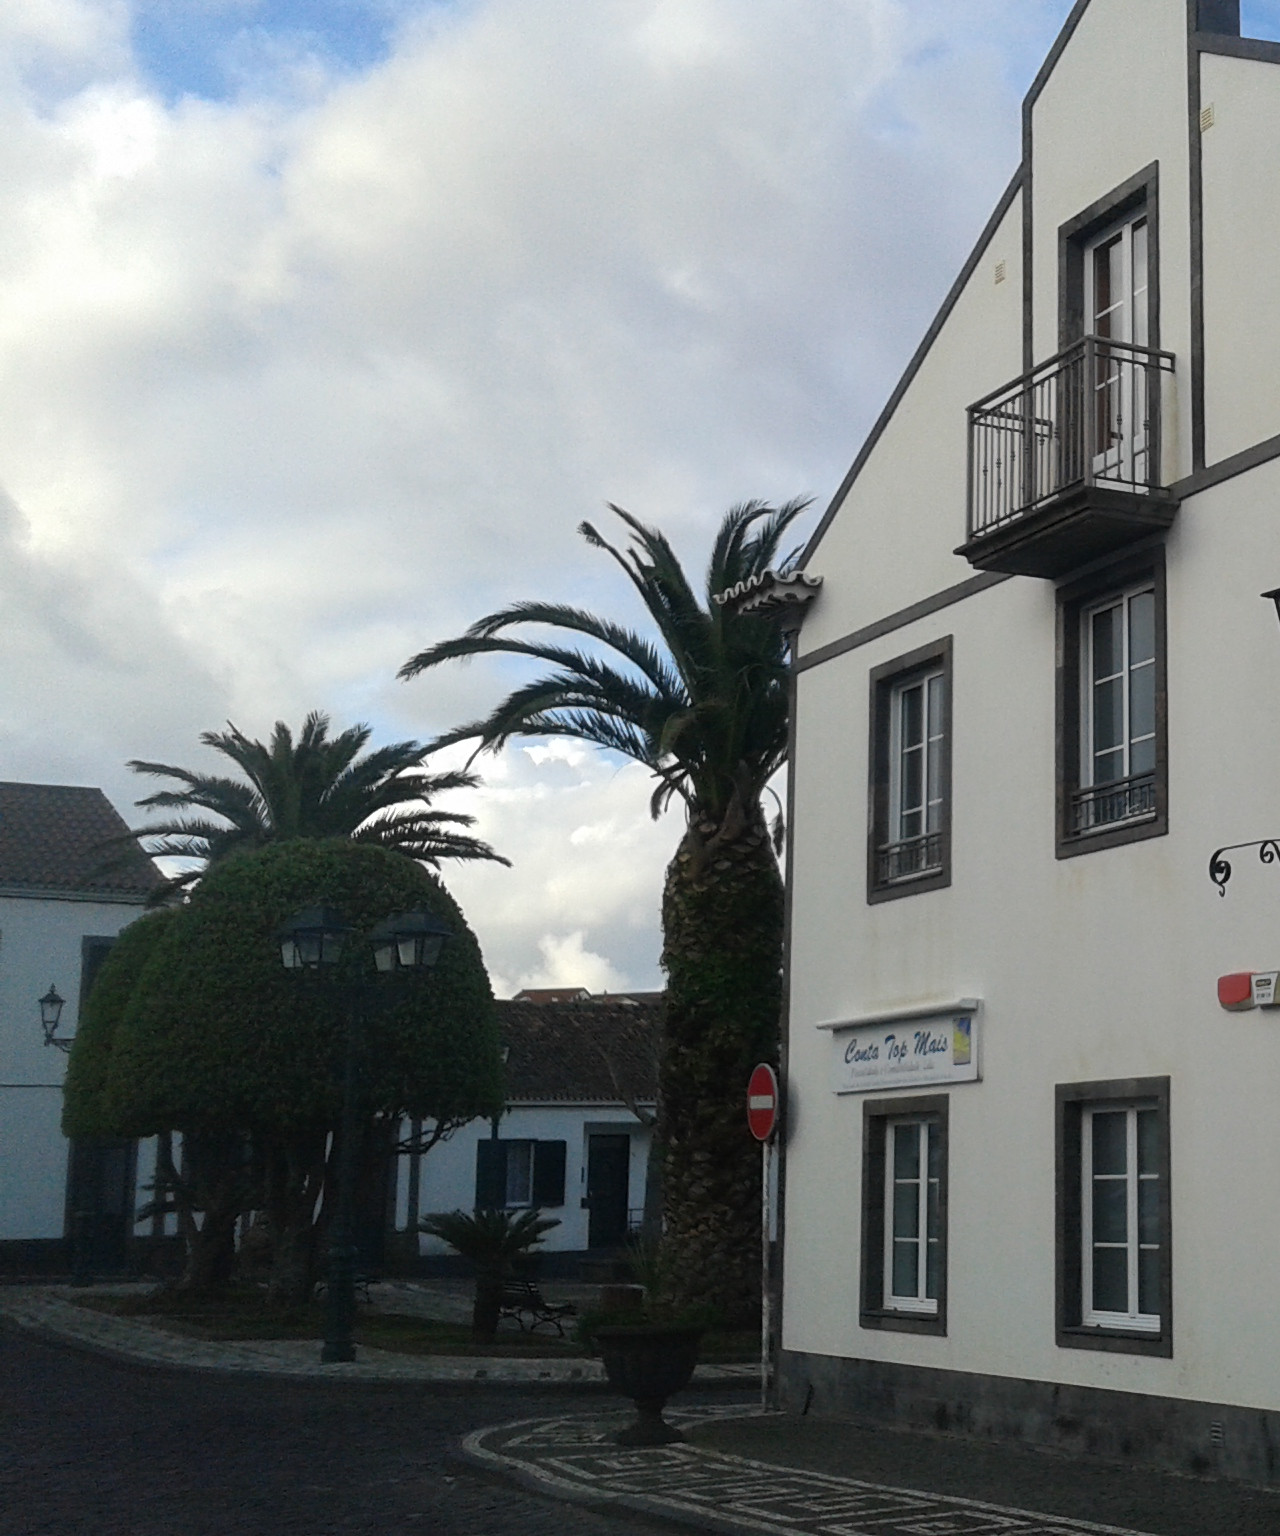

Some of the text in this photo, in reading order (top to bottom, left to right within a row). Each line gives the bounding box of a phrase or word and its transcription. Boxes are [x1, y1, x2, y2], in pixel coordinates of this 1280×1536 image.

[844, 1030, 948, 1064] Conta Top Mais
